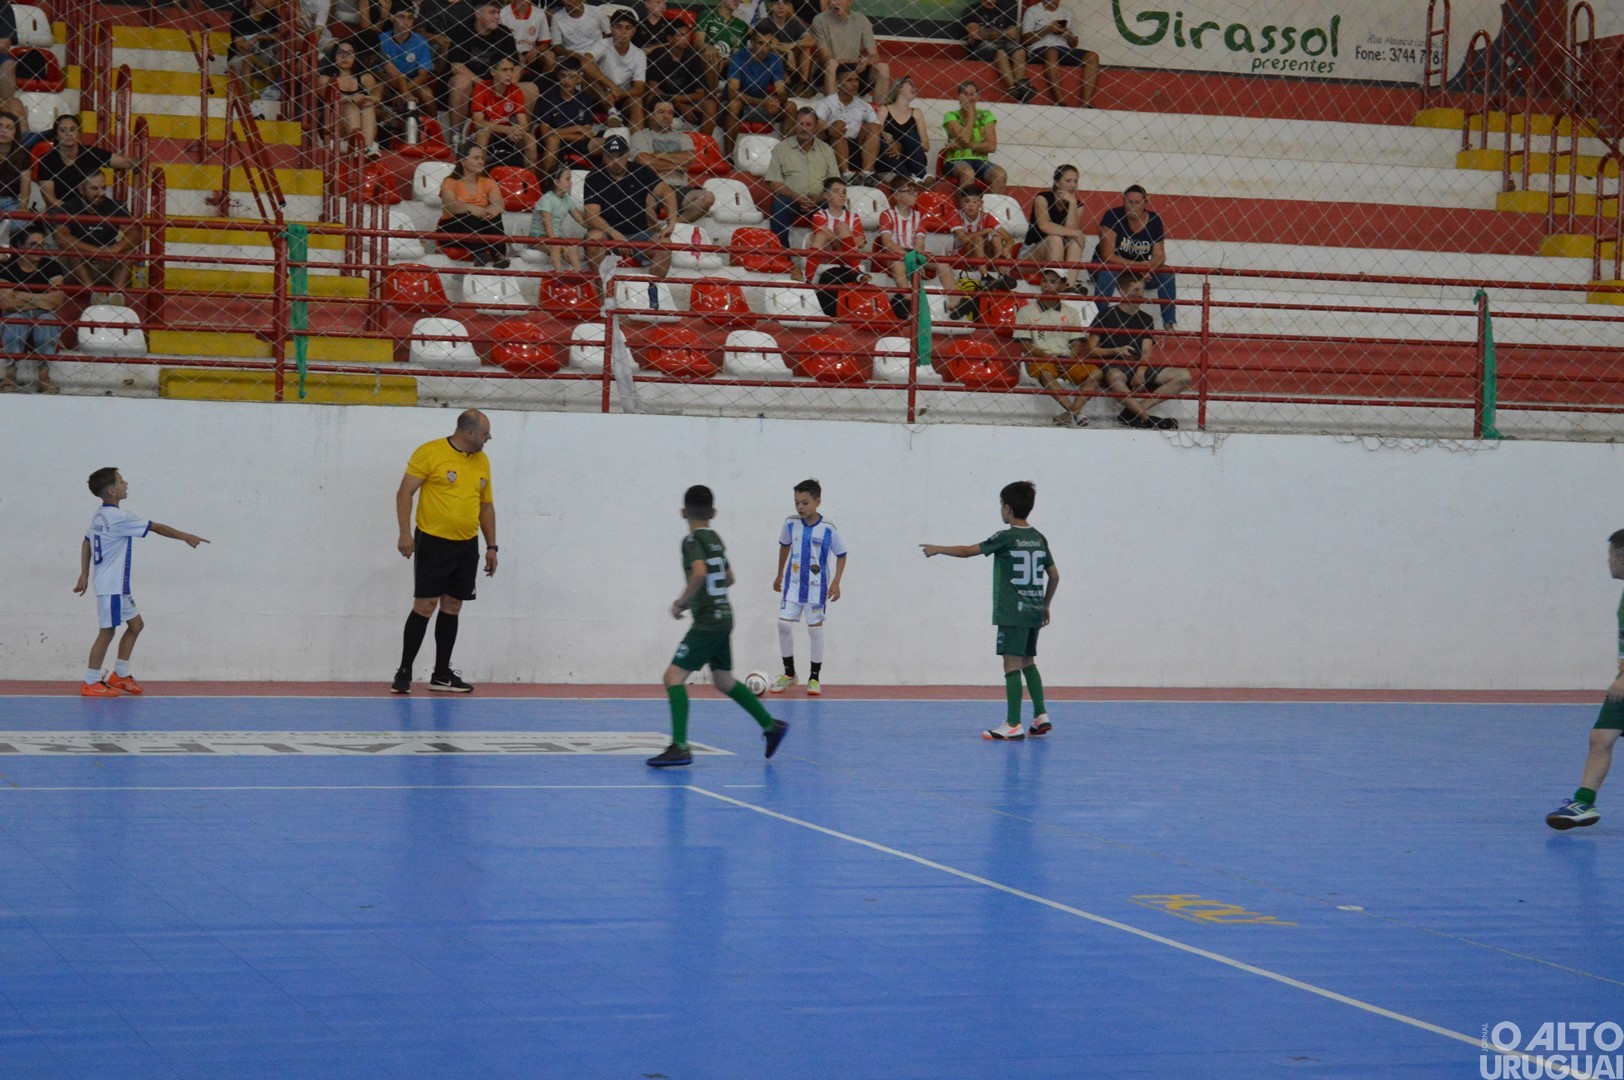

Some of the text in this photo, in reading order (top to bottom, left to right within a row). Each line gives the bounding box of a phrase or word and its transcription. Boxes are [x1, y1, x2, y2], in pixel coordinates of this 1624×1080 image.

[1112, 0, 1341, 58] Girassol
[1251, 55, 1336, 74] presentes
[1355, 45, 1386, 61] Fone:
[1389, 47, 1416, 64] 3744
[1009, 550, 1047, 586] 36
